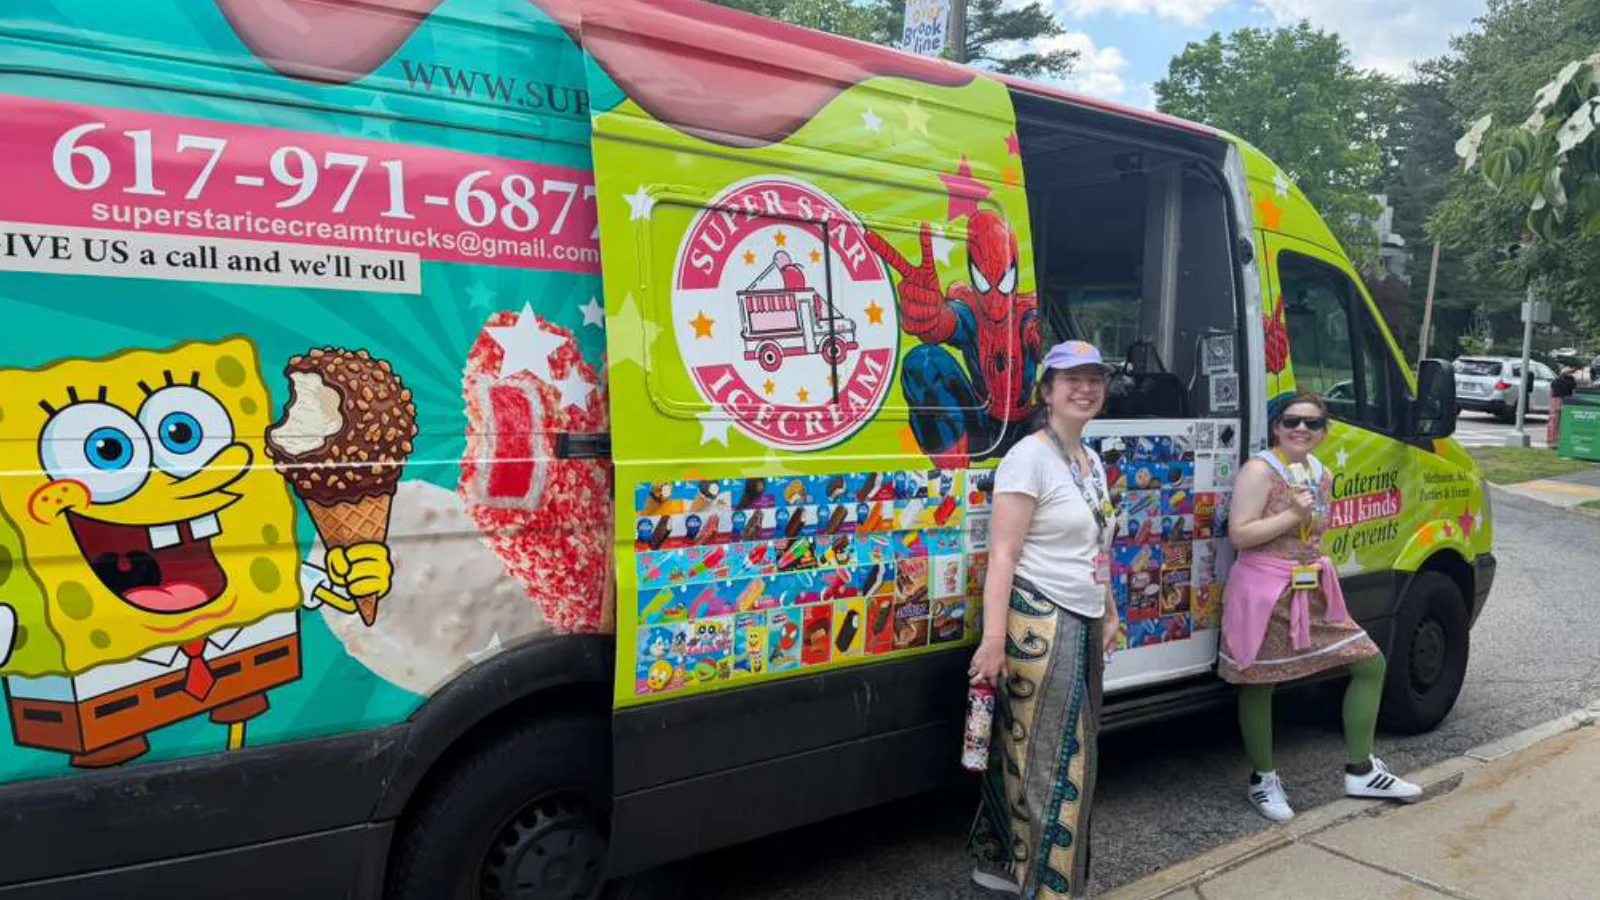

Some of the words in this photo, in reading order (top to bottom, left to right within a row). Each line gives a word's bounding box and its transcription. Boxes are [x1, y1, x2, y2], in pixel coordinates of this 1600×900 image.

[0, 231, 72, 261] IVE
[83, 238, 129, 264] US
[140, 248, 157, 266] a
[166, 245, 218, 269] call
[227, 250, 281, 273] and
[289, 254, 352, 278] we'll
[360, 259, 406, 282] roll
[92, 202, 599, 262] superstaricecreamtrucks@gmail.com
[690, 189, 789, 275] SUPER
[798, 195, 868, 272] STAR
[709, 355, 884, 437] ICECREAM
[1332, 465, 1399, 498] Catering
[1332, 500, 1355, 528] All
[1358, 491, 1398, 521] kinds
[1332, 528, 1351, 559] of
[1352, 521, 1399, 548] events
